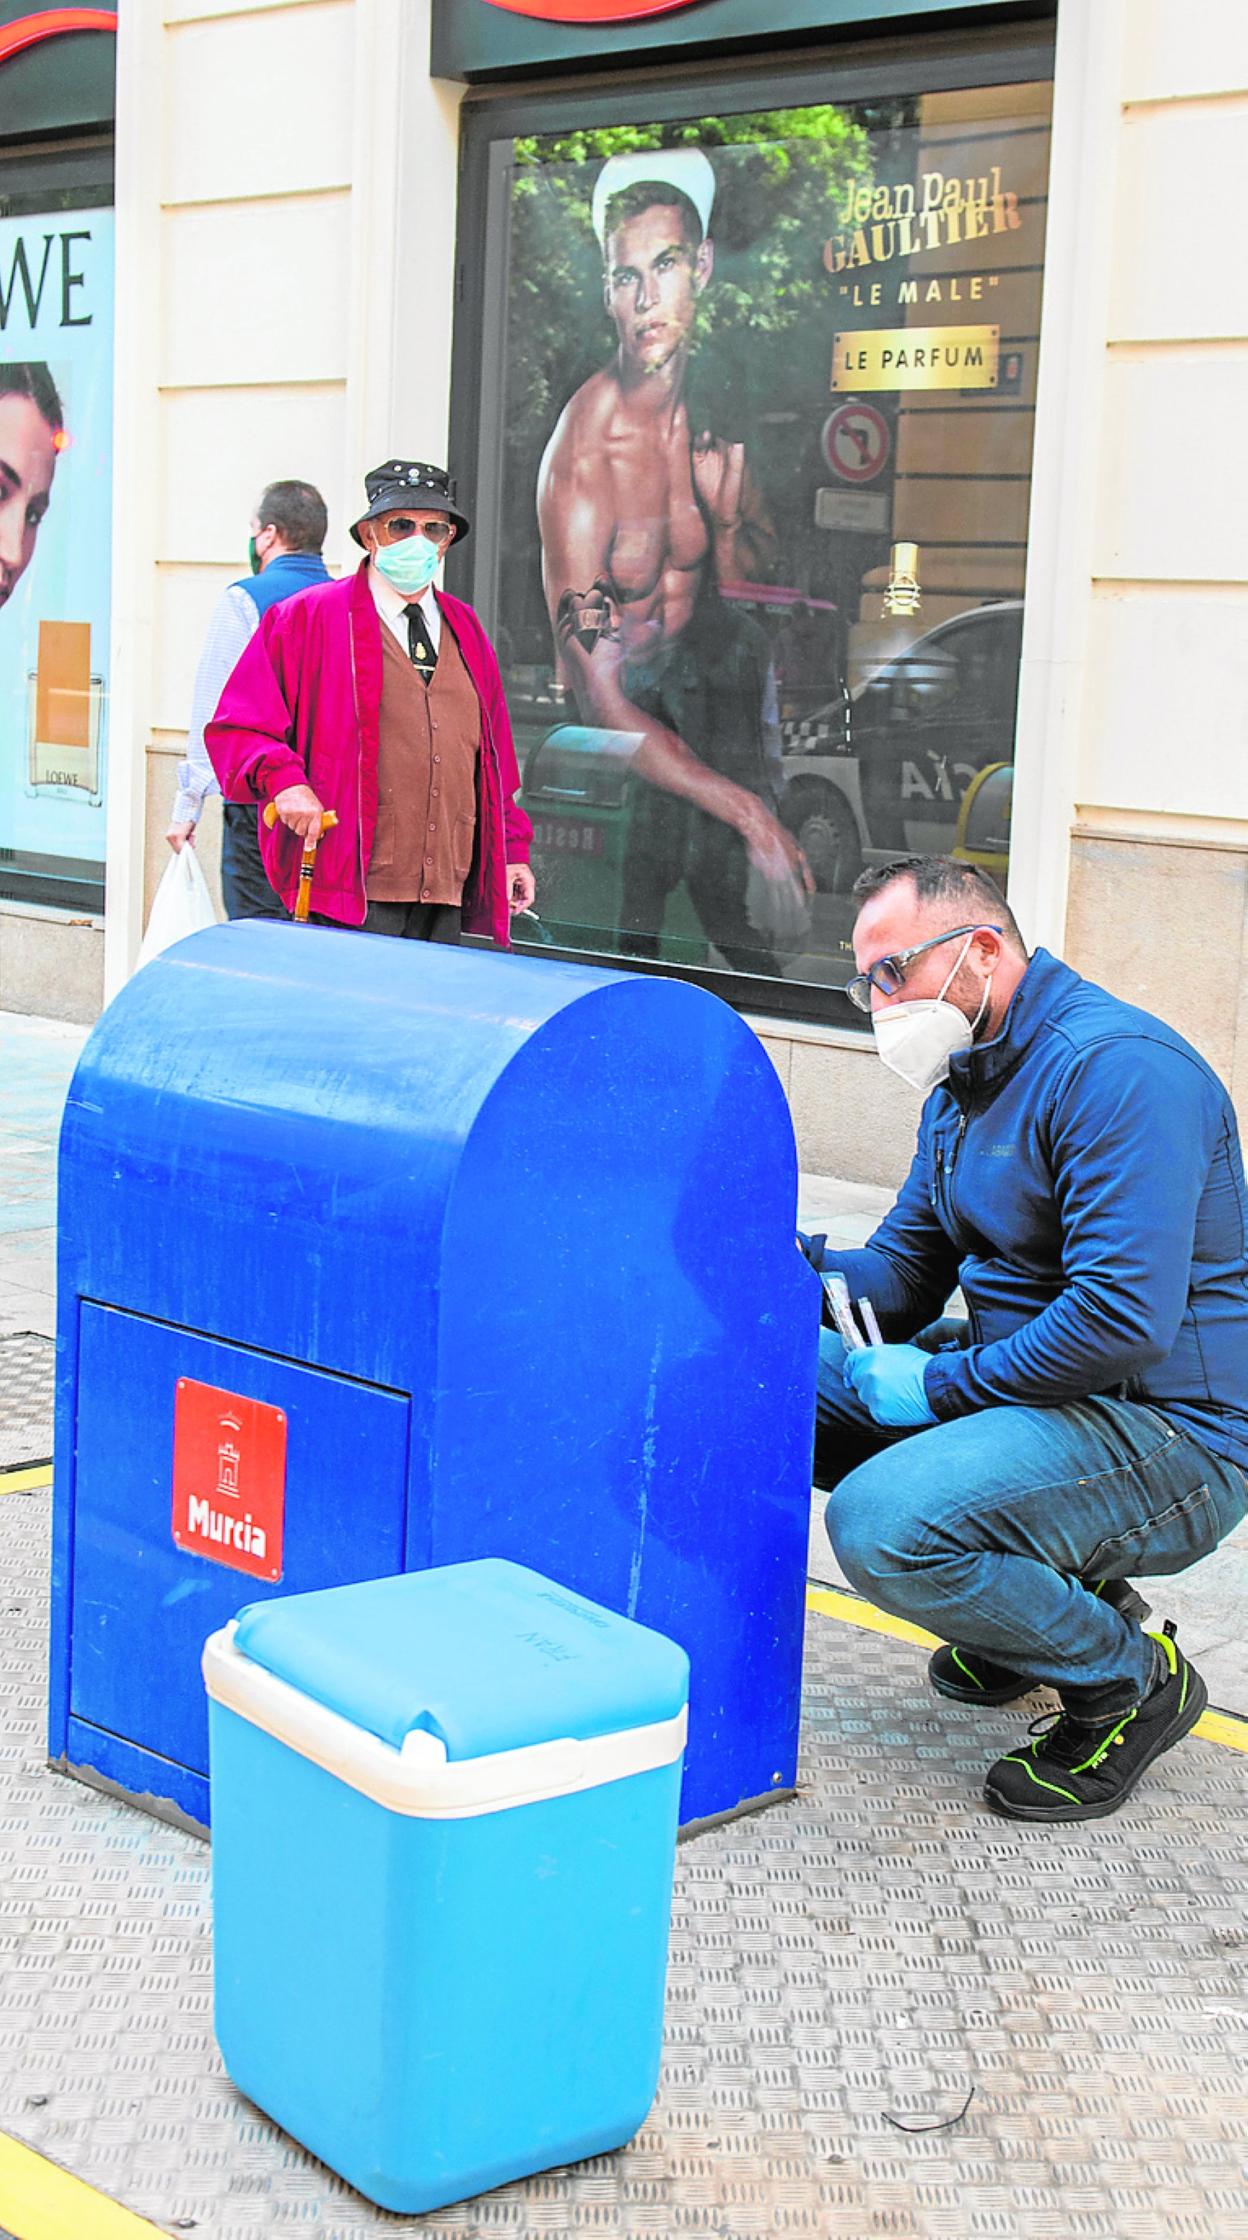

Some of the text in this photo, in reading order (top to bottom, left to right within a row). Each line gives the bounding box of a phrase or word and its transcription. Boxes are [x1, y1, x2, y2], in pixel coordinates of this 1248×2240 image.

[840, 166, 1002, 224] Jean Paul
[823, 191, 1022, 273] GAULTIER
[845, 347, 984, 370] LE PARFUM
[45, 769, 79, 786] LOEWE
[188, 1495, 266, 1558] Murcia
